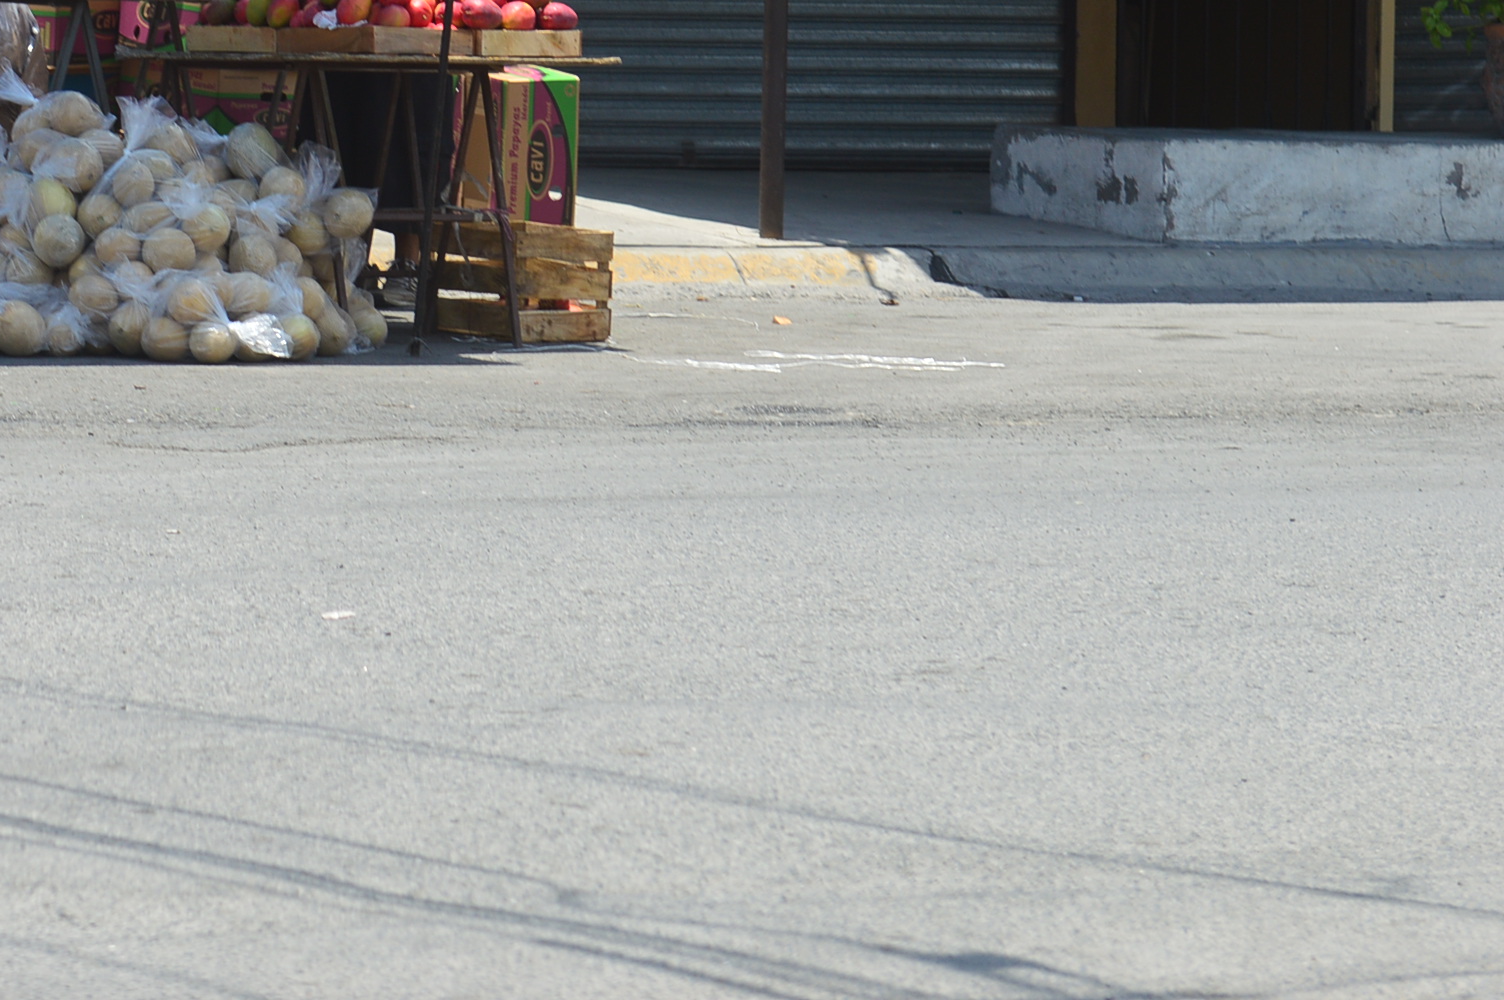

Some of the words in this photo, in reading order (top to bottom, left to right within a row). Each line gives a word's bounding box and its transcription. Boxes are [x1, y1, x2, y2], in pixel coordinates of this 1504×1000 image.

[509, 106, 523, 158] Papayas
[507, 161, 520, 215] Premium
[530, 140, 545, 184] cavi
